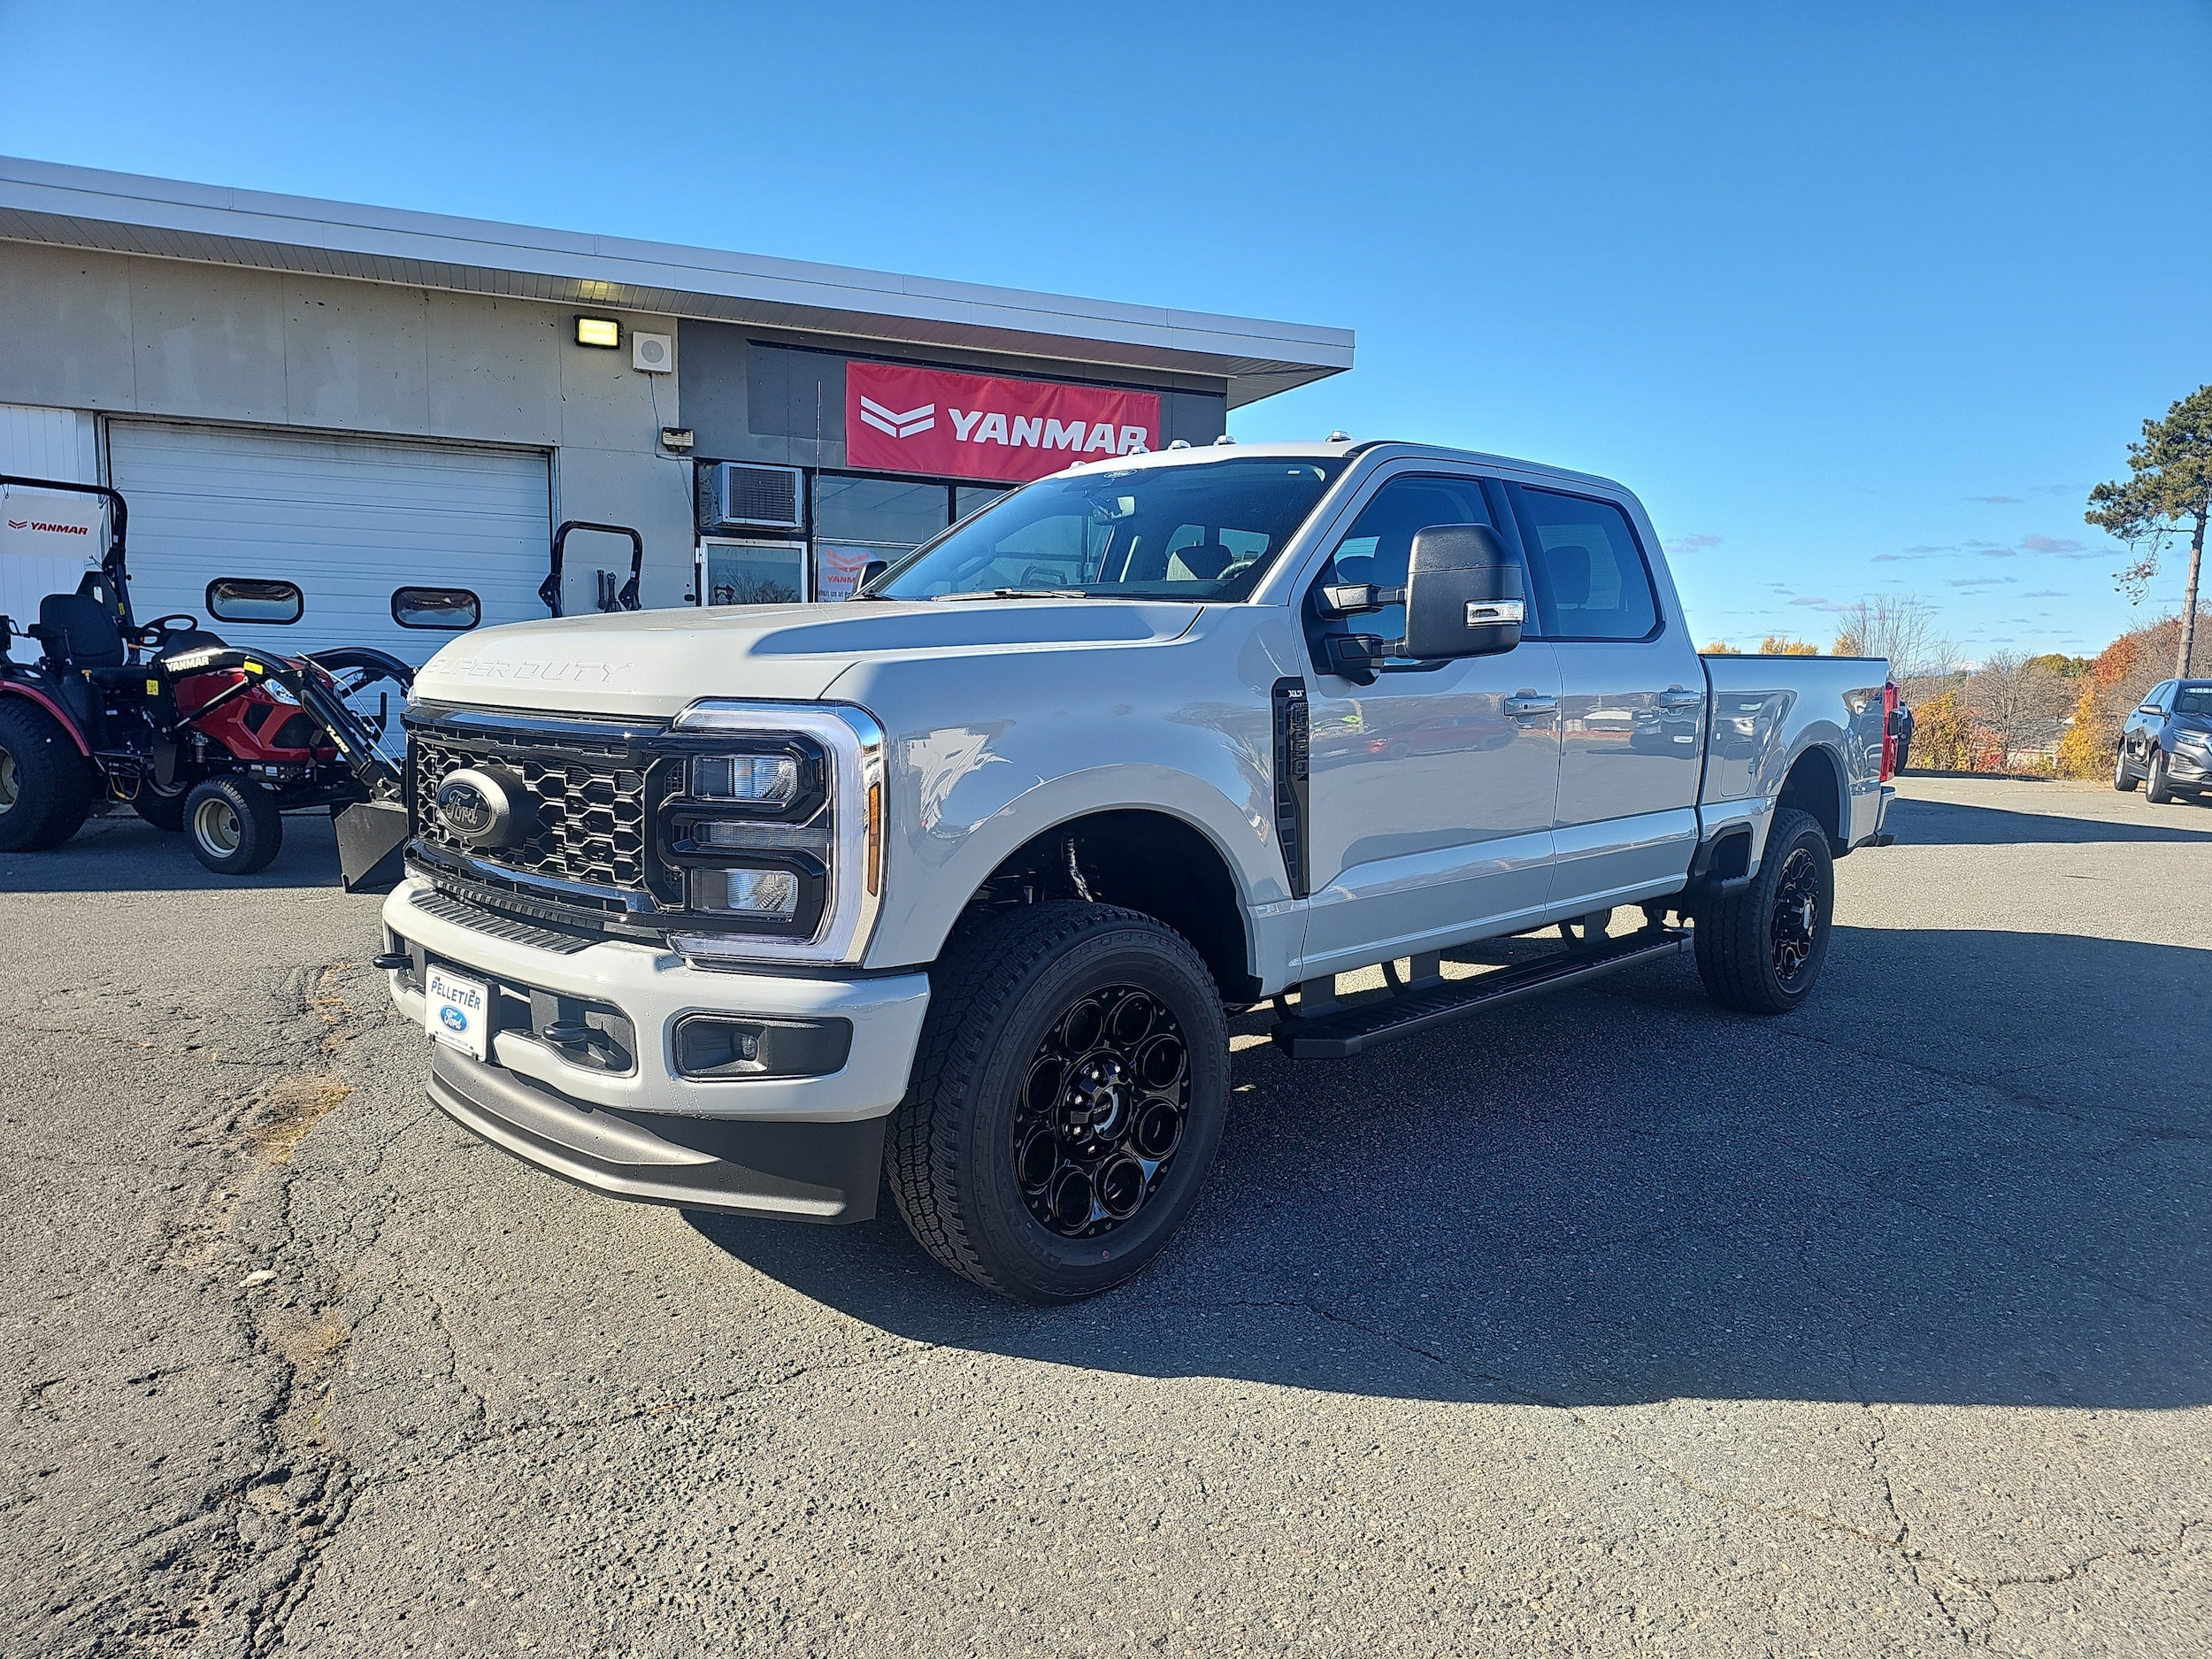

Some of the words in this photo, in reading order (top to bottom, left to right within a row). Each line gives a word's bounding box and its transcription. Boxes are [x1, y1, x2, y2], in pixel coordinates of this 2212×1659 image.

[948, 408, 1148, 456] YANMAR
[30, 521, 88, 535] YANMAR
[826, 575, 856, 584] YANM
[165, 656, 211, 672] YANMAR
[426, 657, 512, 678] SUPER
[512, 661, 636, 683] DUTY
[1287, 689, 1305, 698] XLT
[446, 789, 480, 826] Ford
[430, 979, 481, 1010] PELLETIER
[443, 1009, 464, 1030] Ford
